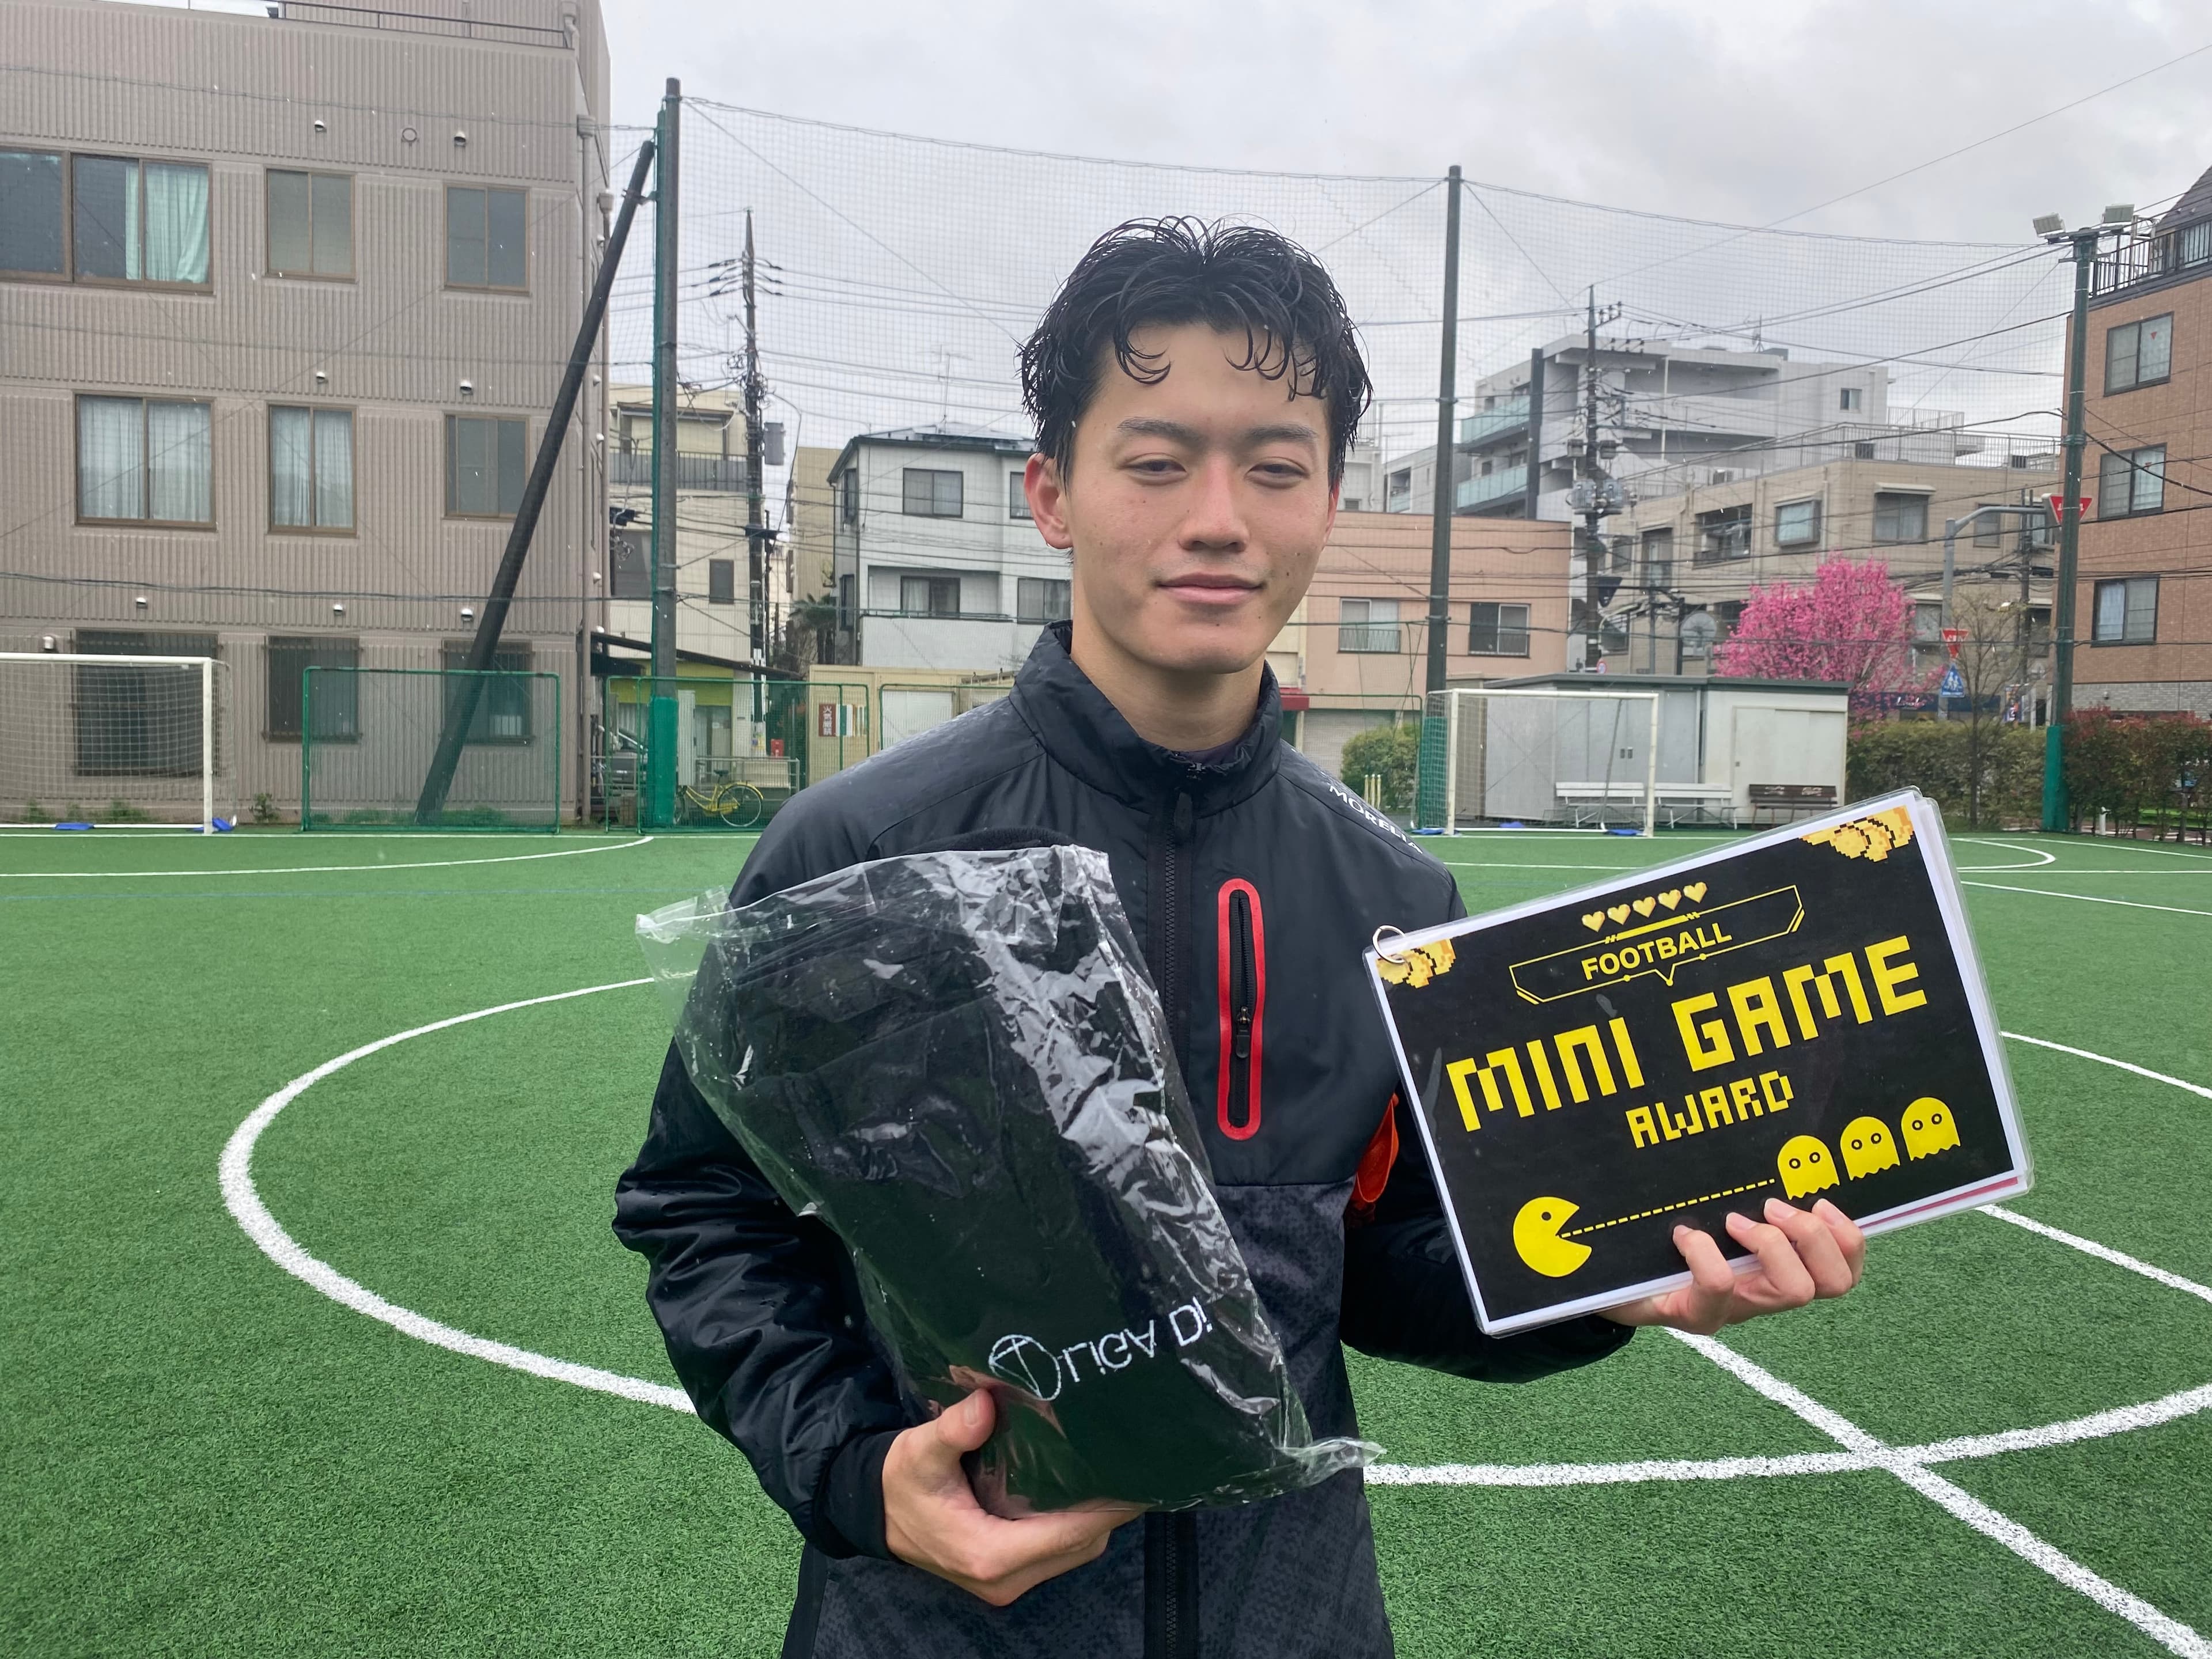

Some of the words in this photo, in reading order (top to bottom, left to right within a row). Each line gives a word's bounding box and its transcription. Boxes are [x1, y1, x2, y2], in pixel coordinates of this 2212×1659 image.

[1329, 785, 1423, 854] MORELIA
[1582, 923, 1732, 980] FOOTBALL
[1446, 1017, 1645, 1132] MINI
[1671, 935, 1927, 1072] GAME
[1626, 1070, 1793, 1149] AWARD
